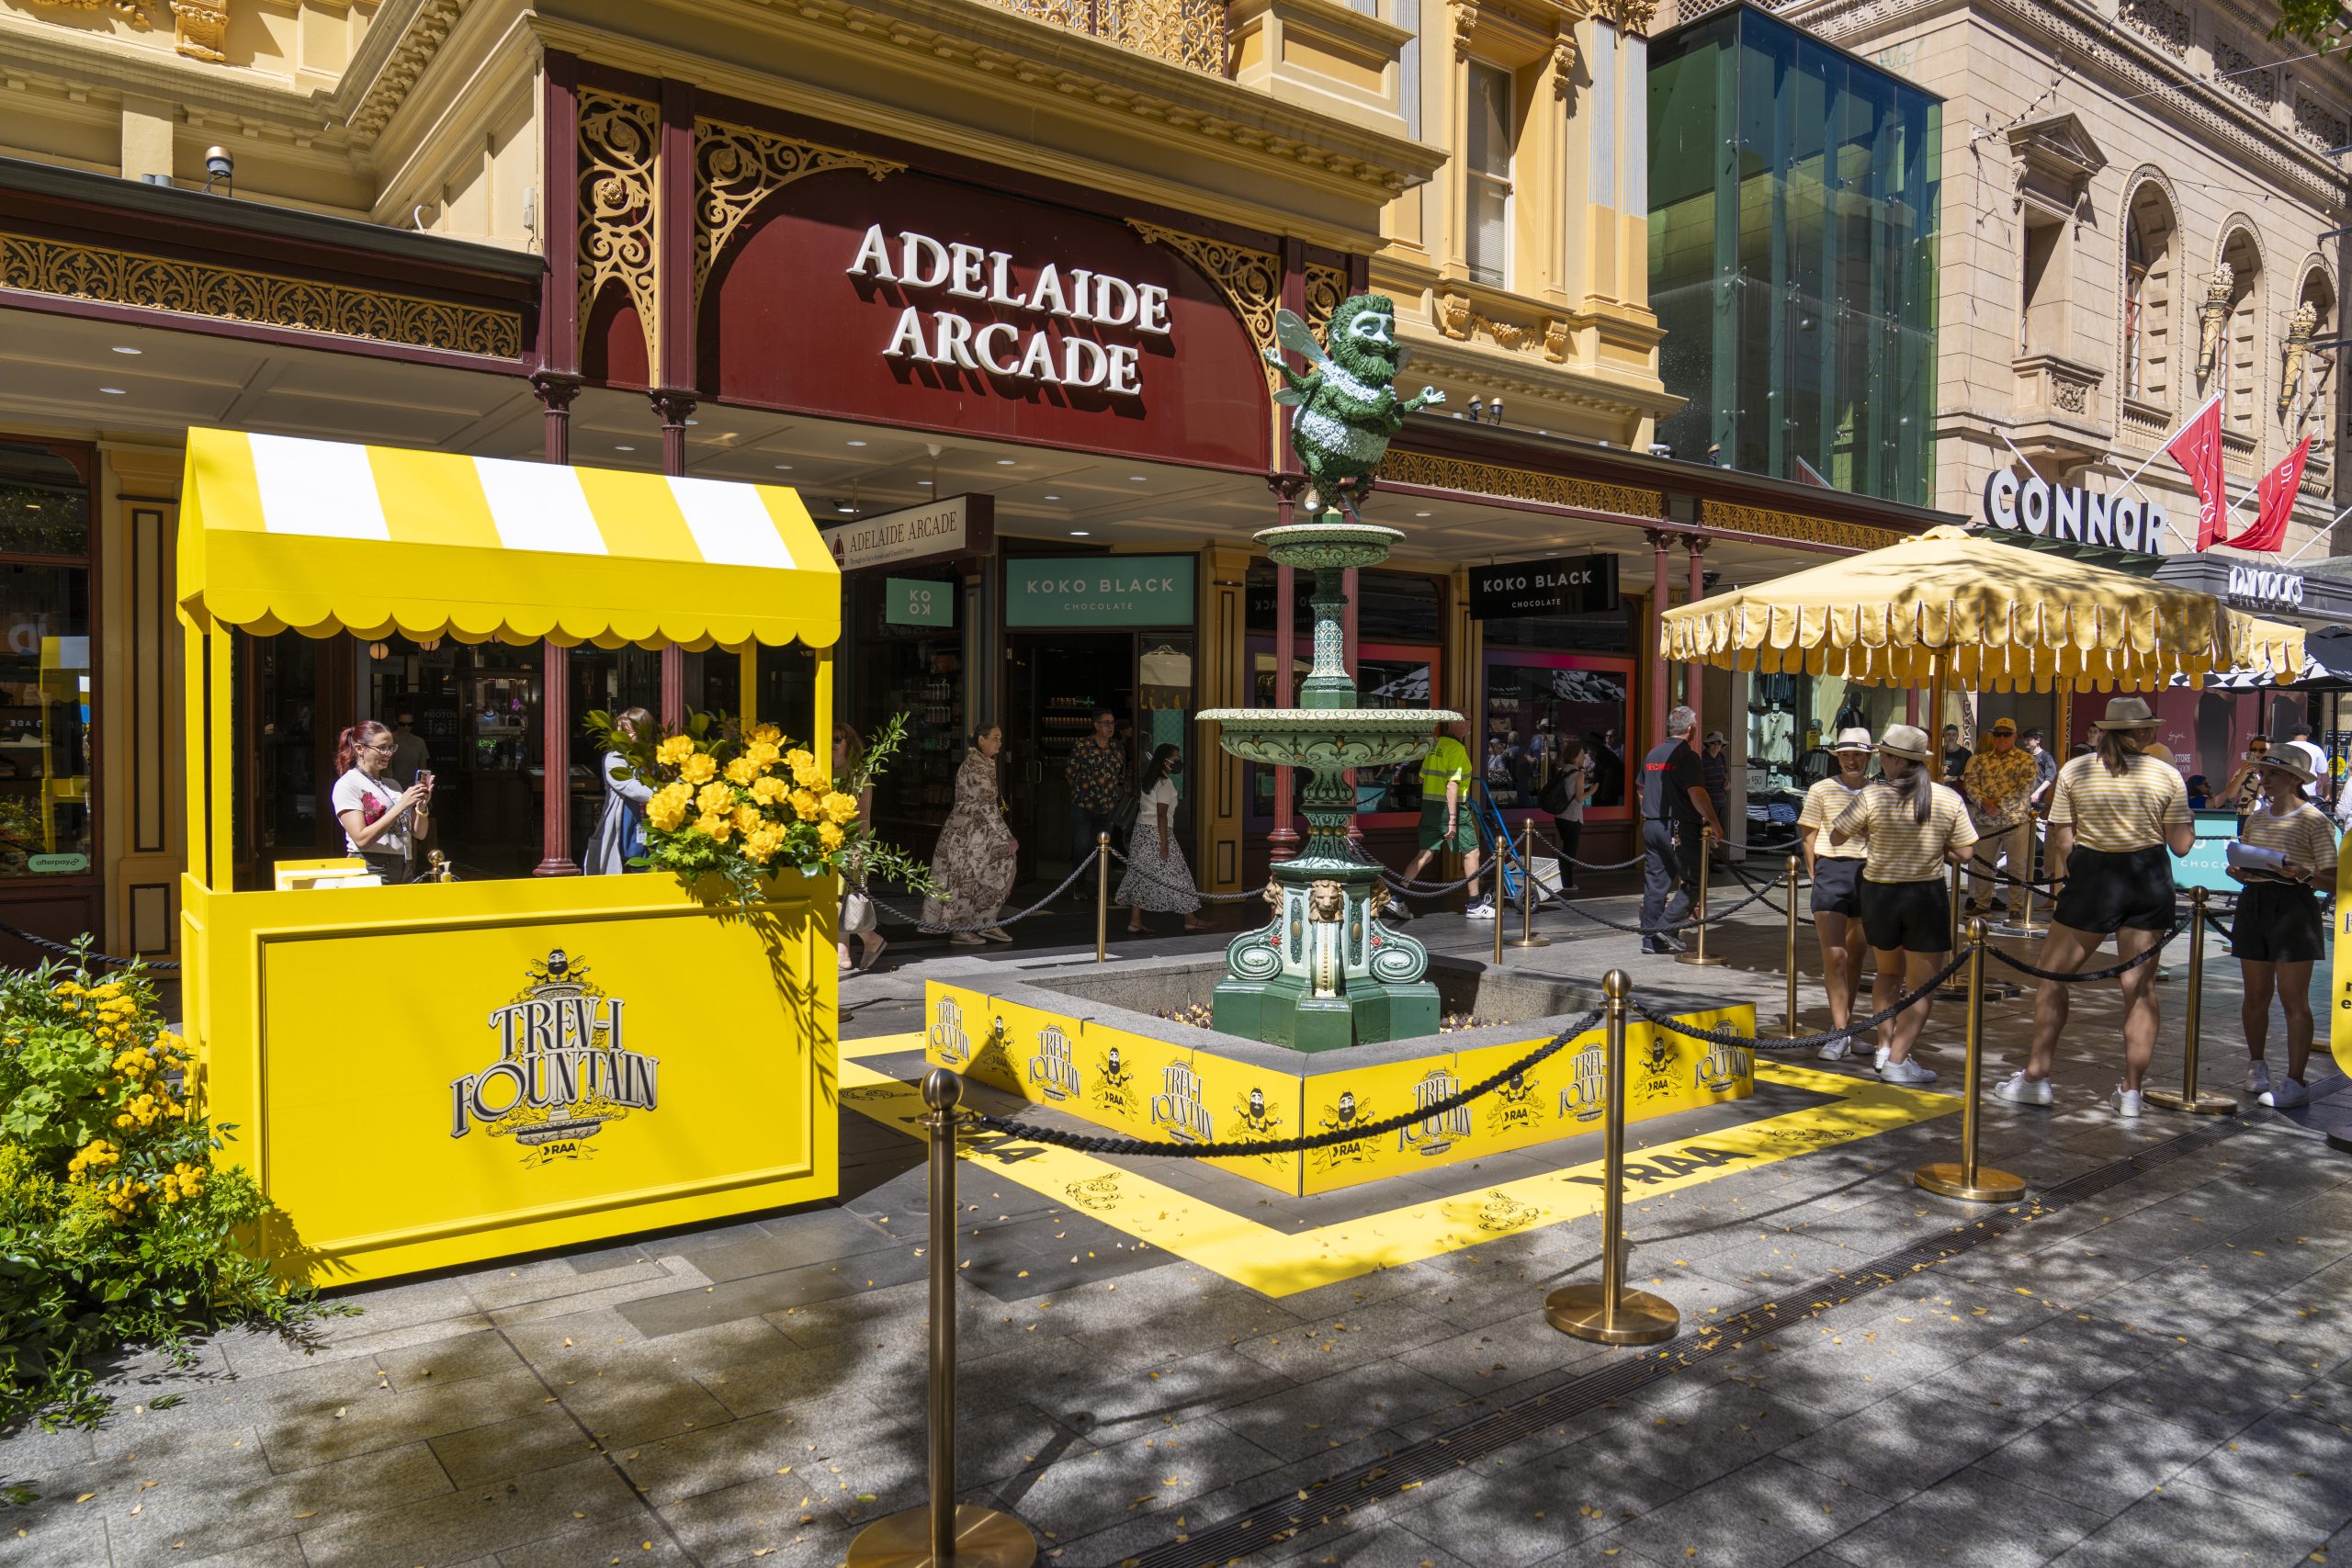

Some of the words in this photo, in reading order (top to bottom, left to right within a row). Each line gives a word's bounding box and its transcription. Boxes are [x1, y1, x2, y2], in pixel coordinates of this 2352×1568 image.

[846, 223, 1171, 334] ADELAIDE
[883, 306, 1141, 396] ARCADE
[1984, 469, 2167, 556] CONNOR
[849, 524, 905, 553] ADELAIDE
[907, 511, 957, 541] ARCADE
[1027, 580, 1087, 593] KOKO
[1099, 578, 1174, 592] BLACK
[1483, 576, 1527, 592] KOKO
[1535, 570, 1592, 588] BLACK
[2229, 566, 2303, 605] DYMOCKS
[1064, 603, 1133, 611] CHOCOLATE
[1511, 598, 1562, 609] CHOCOLATE
[2175, 754, 2191, 762] STORE
[1752, 775, 1762, 785] $50
[2180, 860, 2229, 868] CHOCO
[487, 996, 626, 1063] TREV-I
[1029, 1055, 1081, 1099] FOUNTAIN
[1694, 1049, 1749, 1089] FOUNTAIN
[450, 1049, 660, 1139] FOUNTAIN
[1162, 1067, 1203, 1104] TREV-I
[1653, 1079, 1668, 1090] RAA
[1109, 1094, 1124, 1107] RAA
[1511, 1108, 1529, 1121] RAA
[1151, 1093, 1214, 1144] FOUNTAIN
[551, 1142, 577, 1155] RAA
[1339, 1143, 1361, 1156] RAA
[1600, 1145, 1757, 1192] RAA
